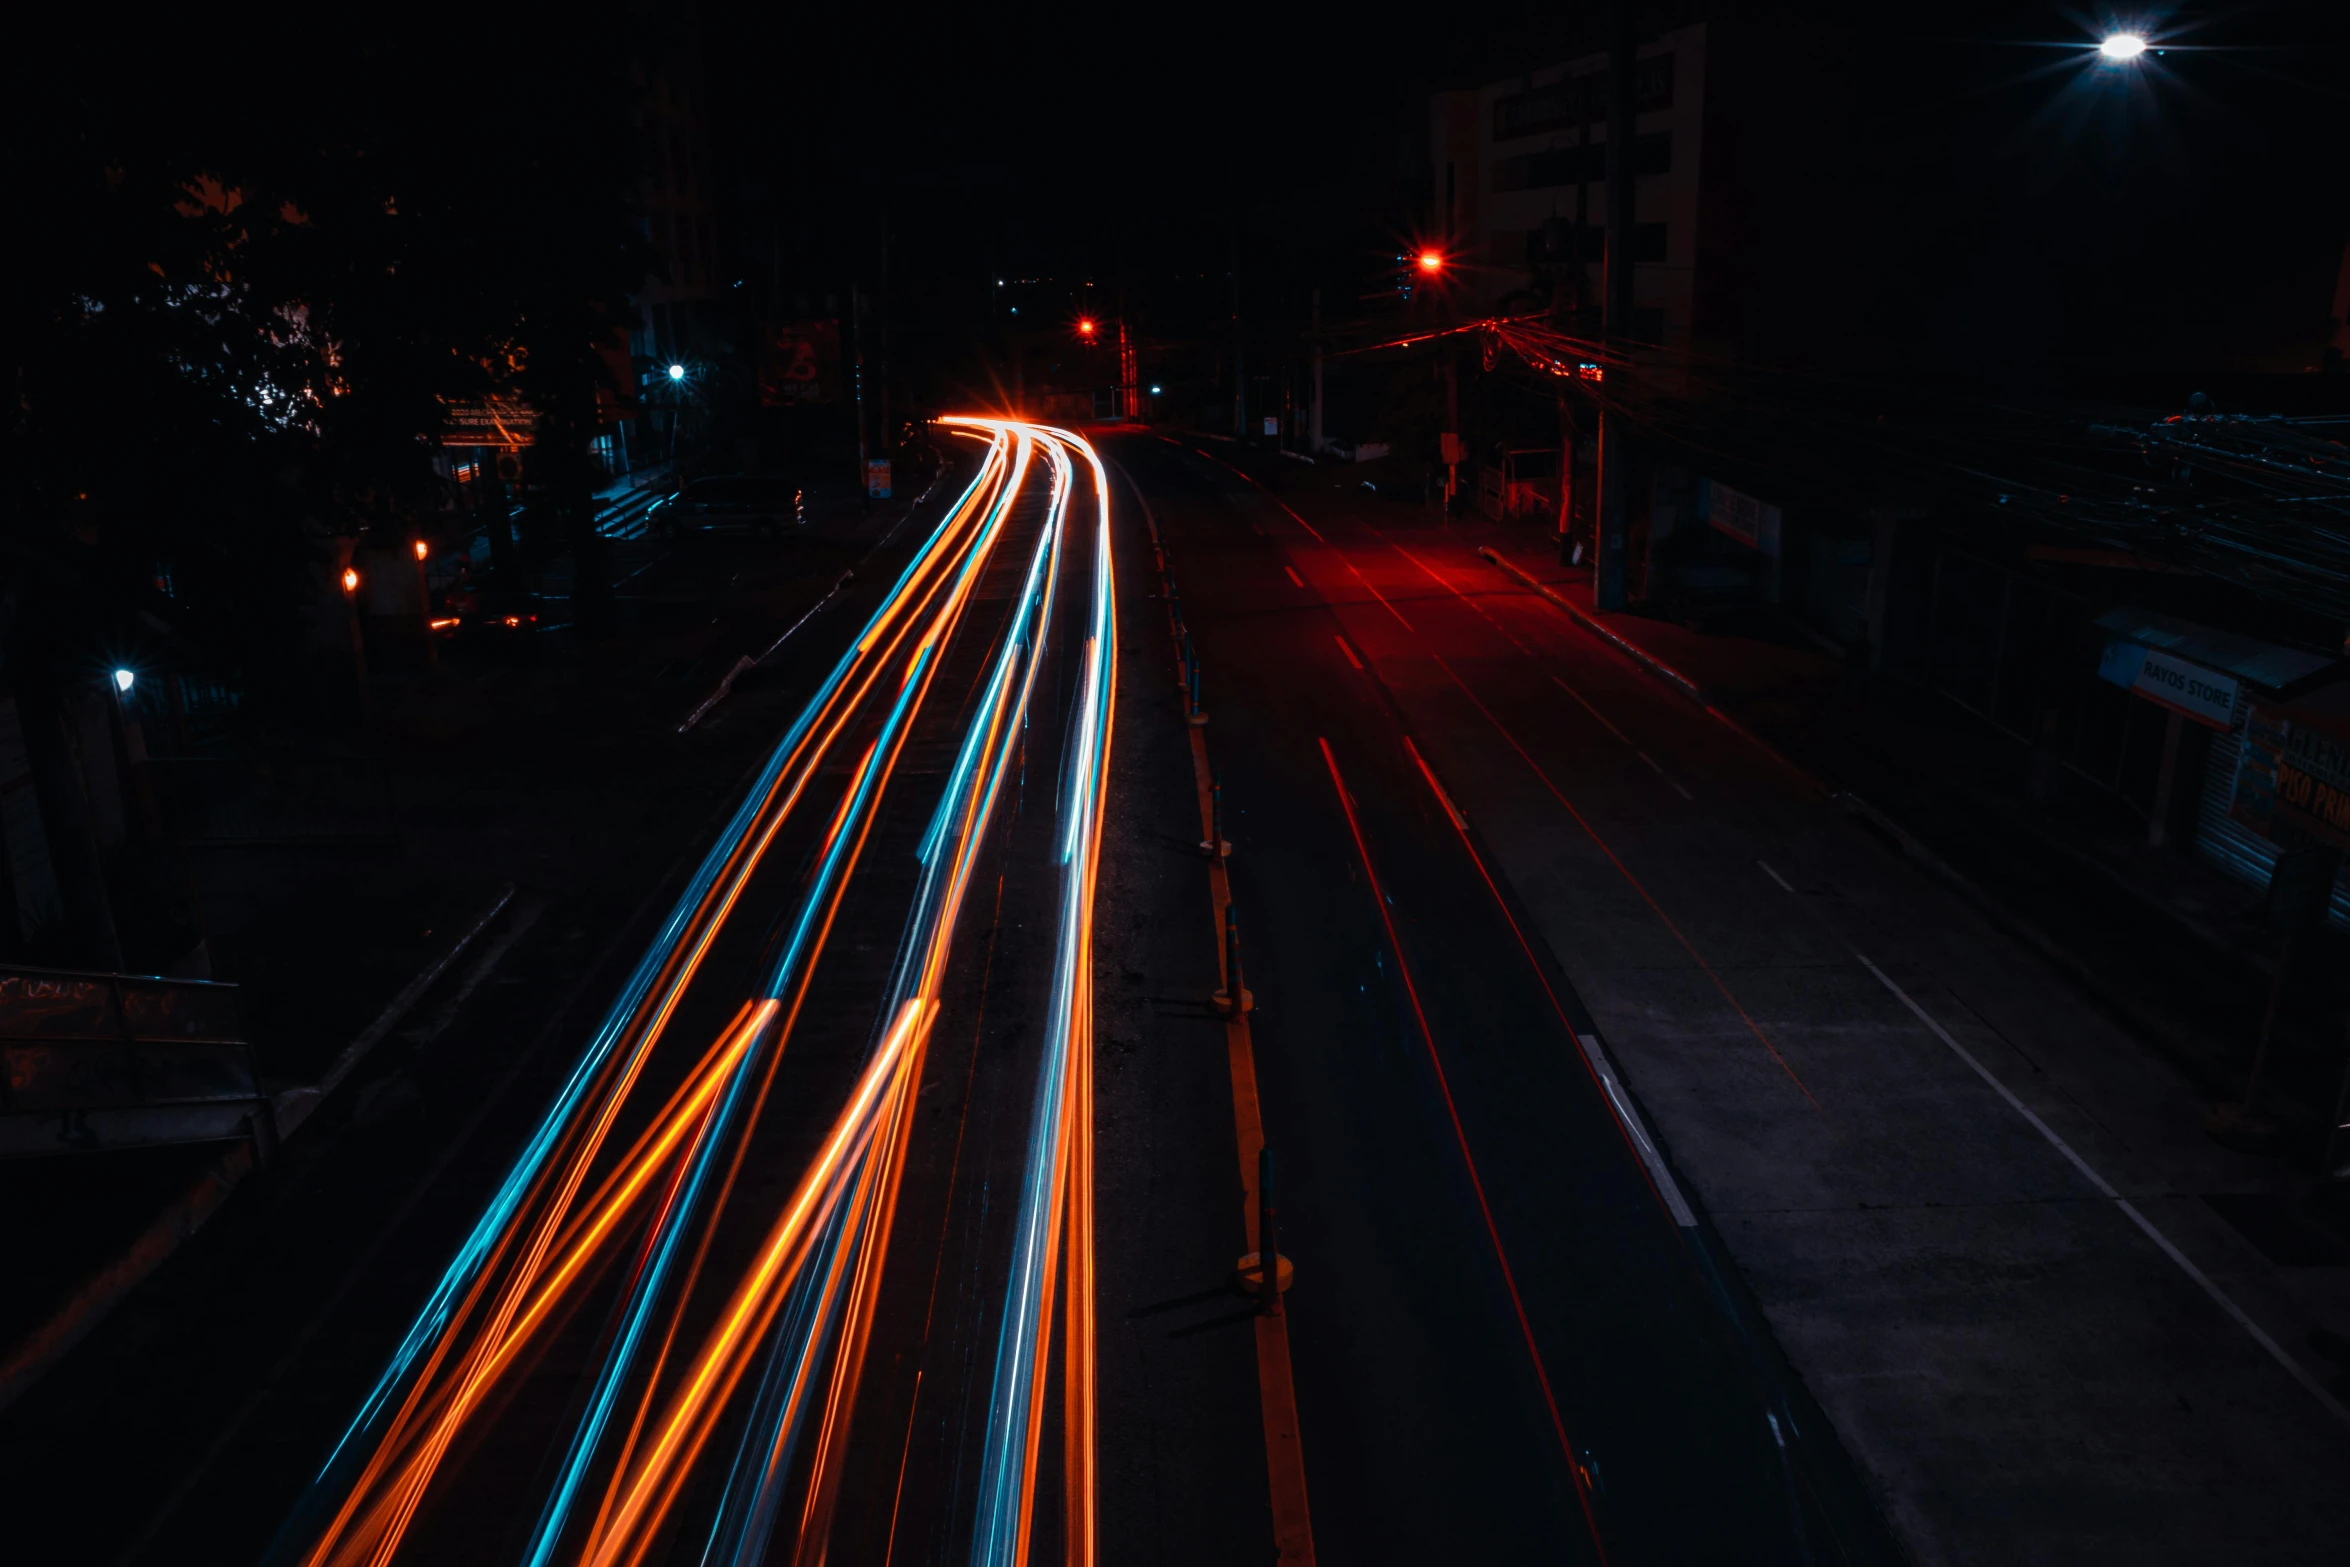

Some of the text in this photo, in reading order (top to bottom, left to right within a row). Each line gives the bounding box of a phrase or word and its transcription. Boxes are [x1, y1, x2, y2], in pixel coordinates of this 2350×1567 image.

[2143, 661, 2231, 709] RAYOS STORE
[2276, 763, 2312, 808] PISO
